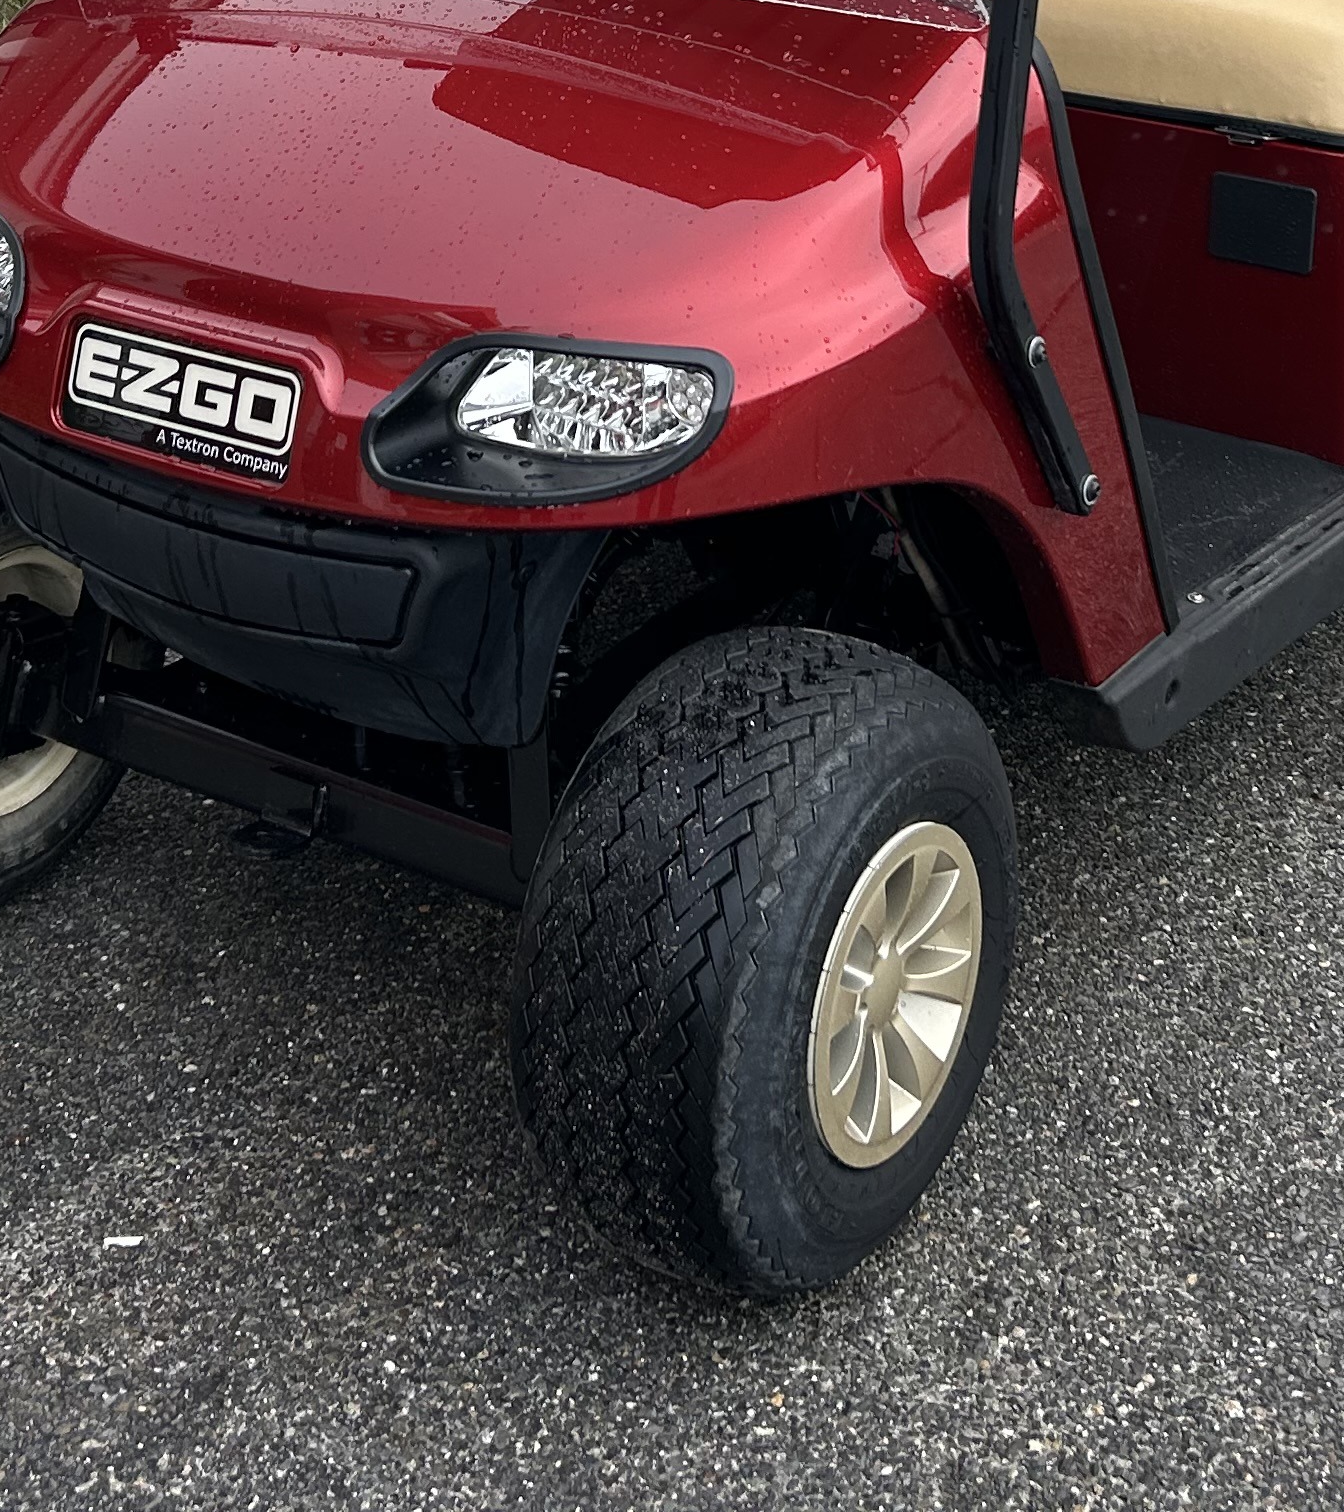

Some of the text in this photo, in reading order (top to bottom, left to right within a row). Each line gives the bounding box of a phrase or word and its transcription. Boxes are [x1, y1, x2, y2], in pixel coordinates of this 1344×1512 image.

[75, 336, 293, 443] EZGO
[156, 428, 288, 479] A Textron Company
